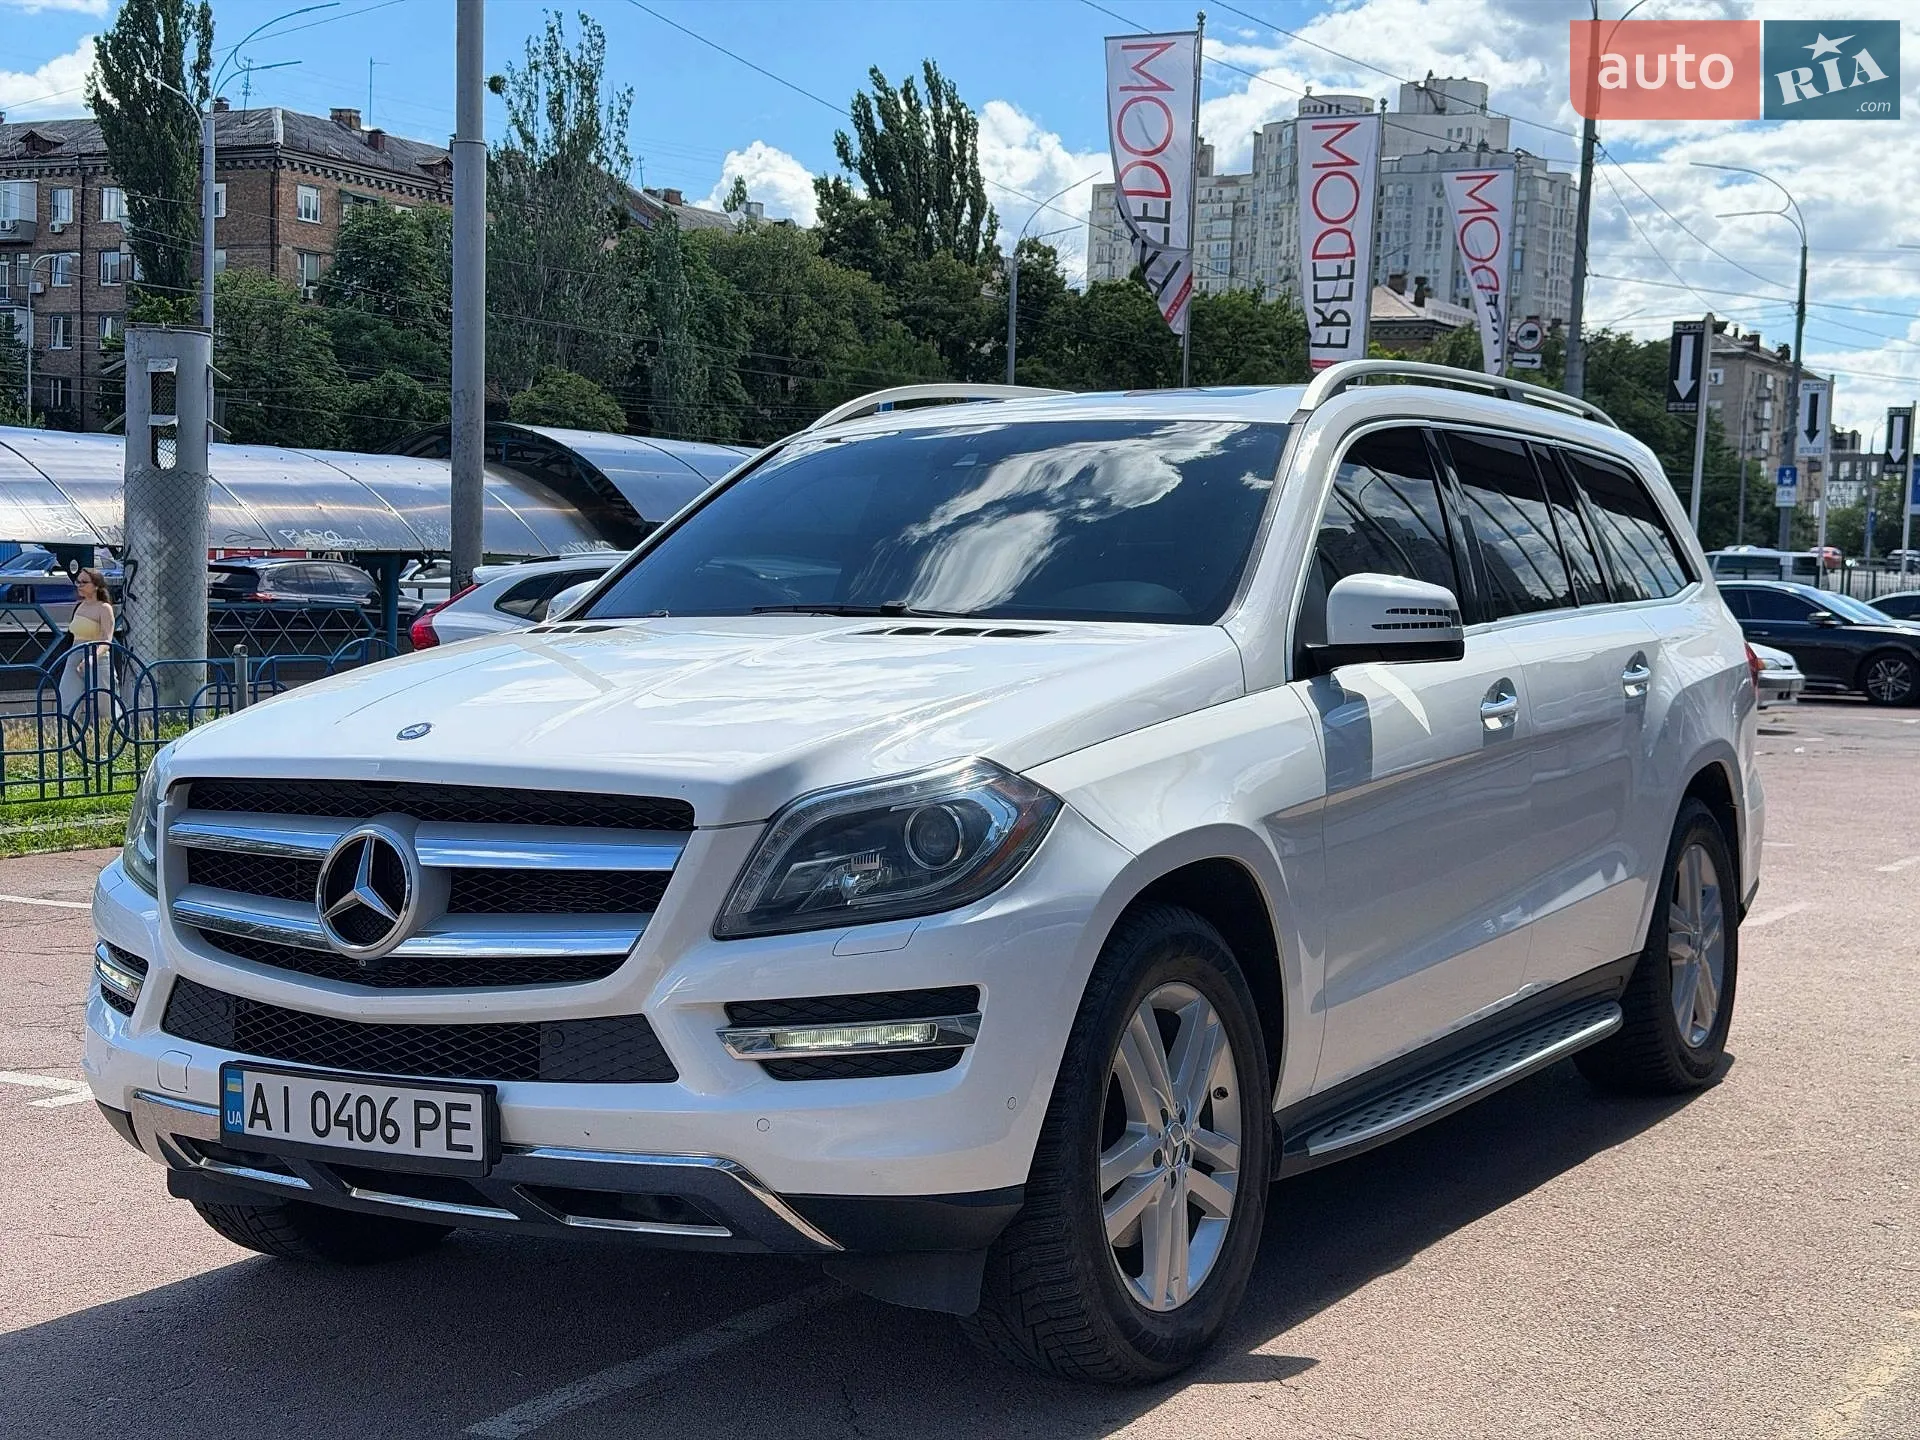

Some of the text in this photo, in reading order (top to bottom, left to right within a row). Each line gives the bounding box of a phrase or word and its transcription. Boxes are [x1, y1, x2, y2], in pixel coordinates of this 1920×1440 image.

[227, 1110, 242, 1126] UA
[248, 1082, 474, 1153] AI 0406 PE
